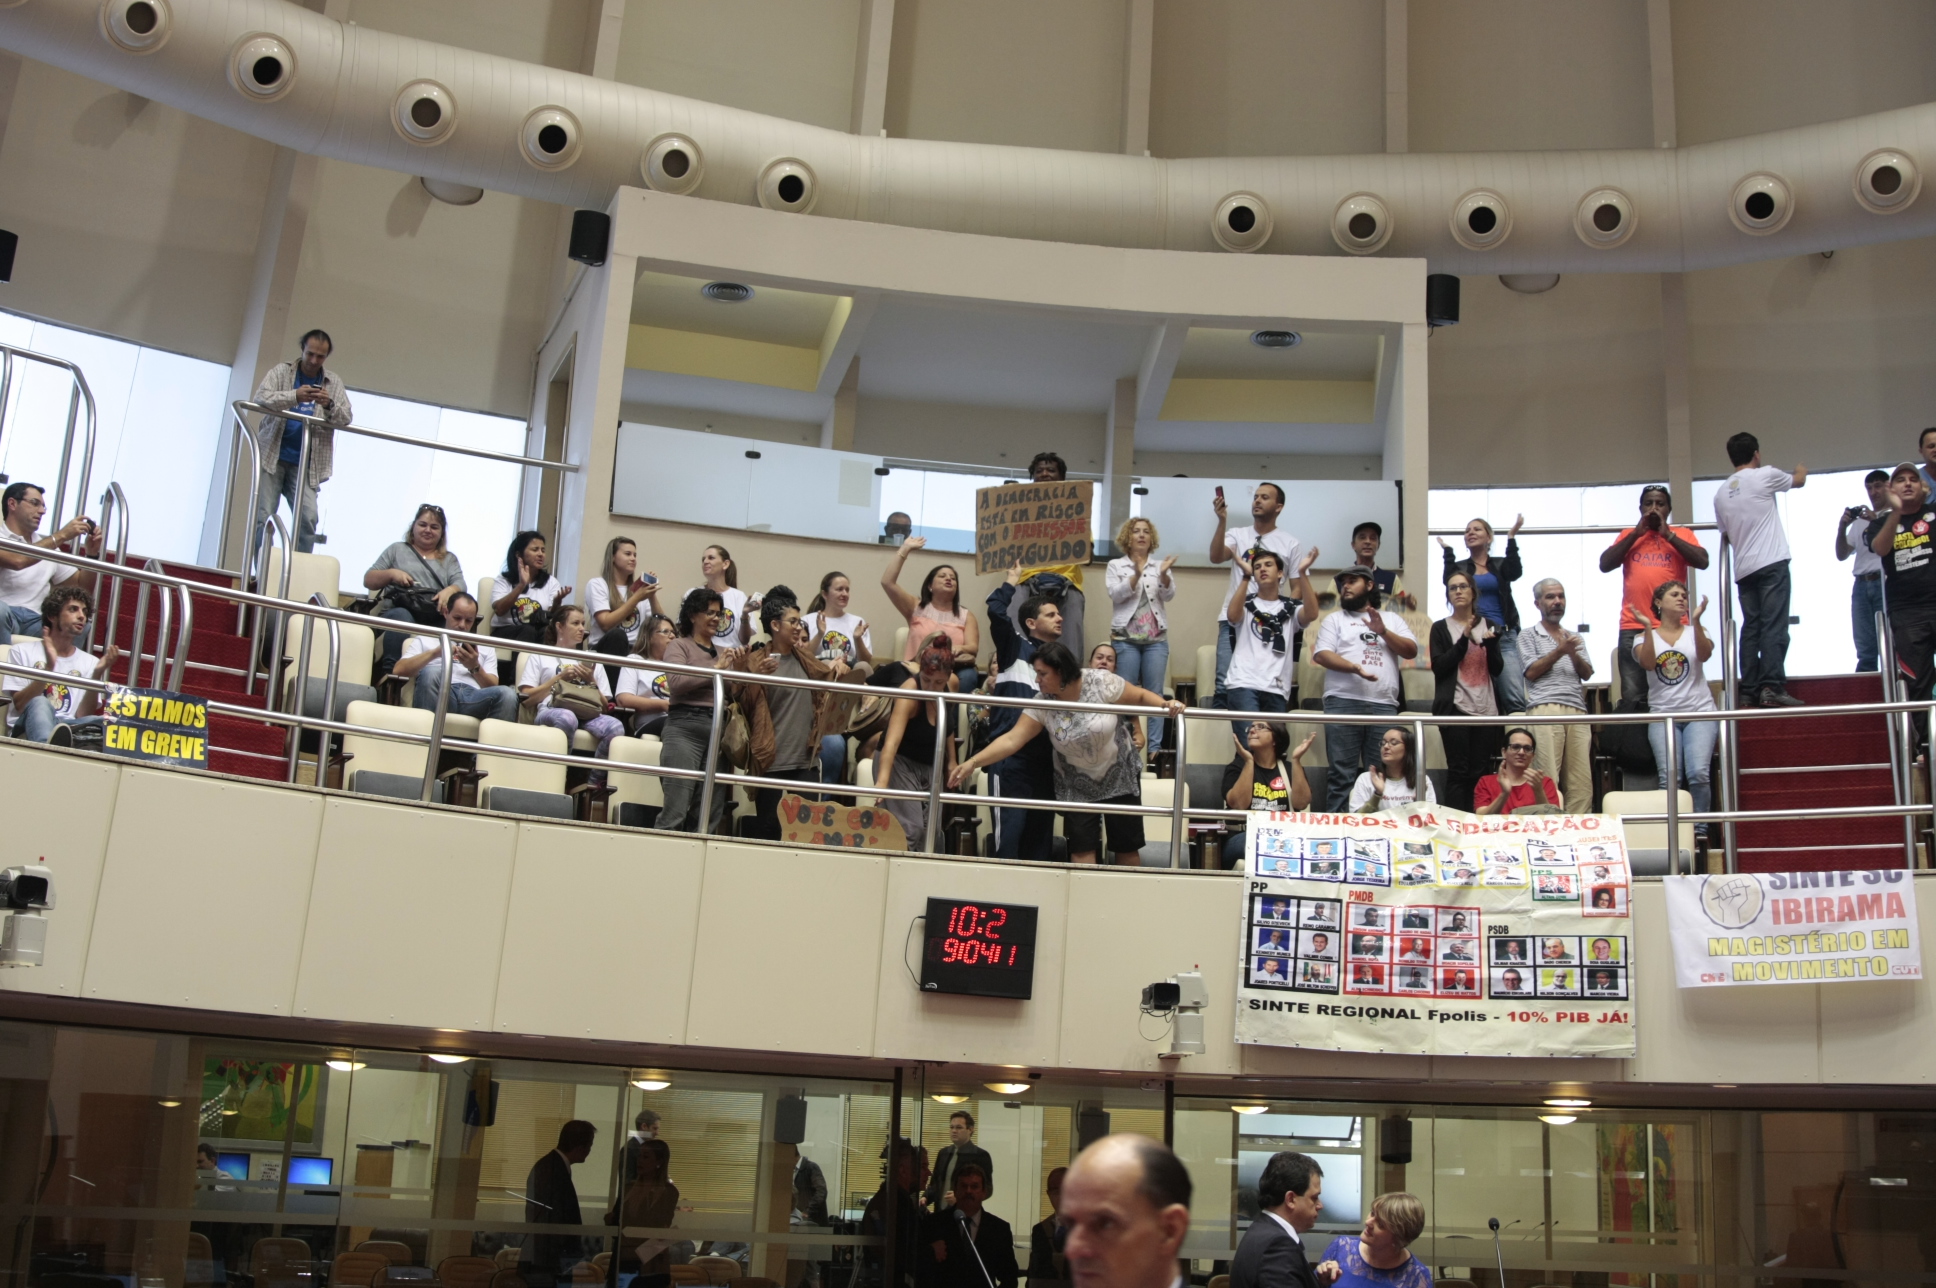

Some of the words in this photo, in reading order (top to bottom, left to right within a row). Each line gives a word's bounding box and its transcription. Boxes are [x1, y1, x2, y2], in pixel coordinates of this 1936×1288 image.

[980, 490, 989, 510] A
[980, 508, 1008, 530] ESTÁ
[1011, 508, 1030, 523] EM
[978, 531, 997, 553] COM
[1002, 526, 1009, 541] O
[1013, 518, 1086, 540] PROFESSOR
[1632, 552, 1672, 563] QATAR
[1656, 651, 1685, 665] SINTE-SC
[110, 693, 206, 728] ESTAMOS
[105, 725, 137, 751] EM
[141, 730, 204, 760] GREVE
[781, 796, 835, 827] VOTE
[847, 808, 890, 831] COM
[1270, 810, 1398, 829] INIMIGOS
[1408, 813, 1440, 829] DA
[1446, 816, 1600, 835] EDUCAÇÃO
[810, 831, 865, 848] AMOR
[1251, 882, 1268, 892] PP
[1349, 890, 1374, 902] PMDB
[1771, 892, 1906, 925] IBIRAMA
[1488, 925, 1509, 934] PSDB
[1707, 930, 1866, 956] MAGISTÉRIO
[1872, 928, 1909, 949] EM
[1732, 956, 1889, 981] MOVIMENTO
[1892, 965, 1919, 975] CUT
[1249, 999, 1310, 1014] SINTE
[1316, 1003, 1422, 1020] REGIONAL
[1428, 1009, 1487, 1024] Fpolis
[1507, 1011, 1549, 1024] 10%
[1556, 1012, 1590, 1024] PIB
[1597, 1010, 1629, 1024] JÁ!
